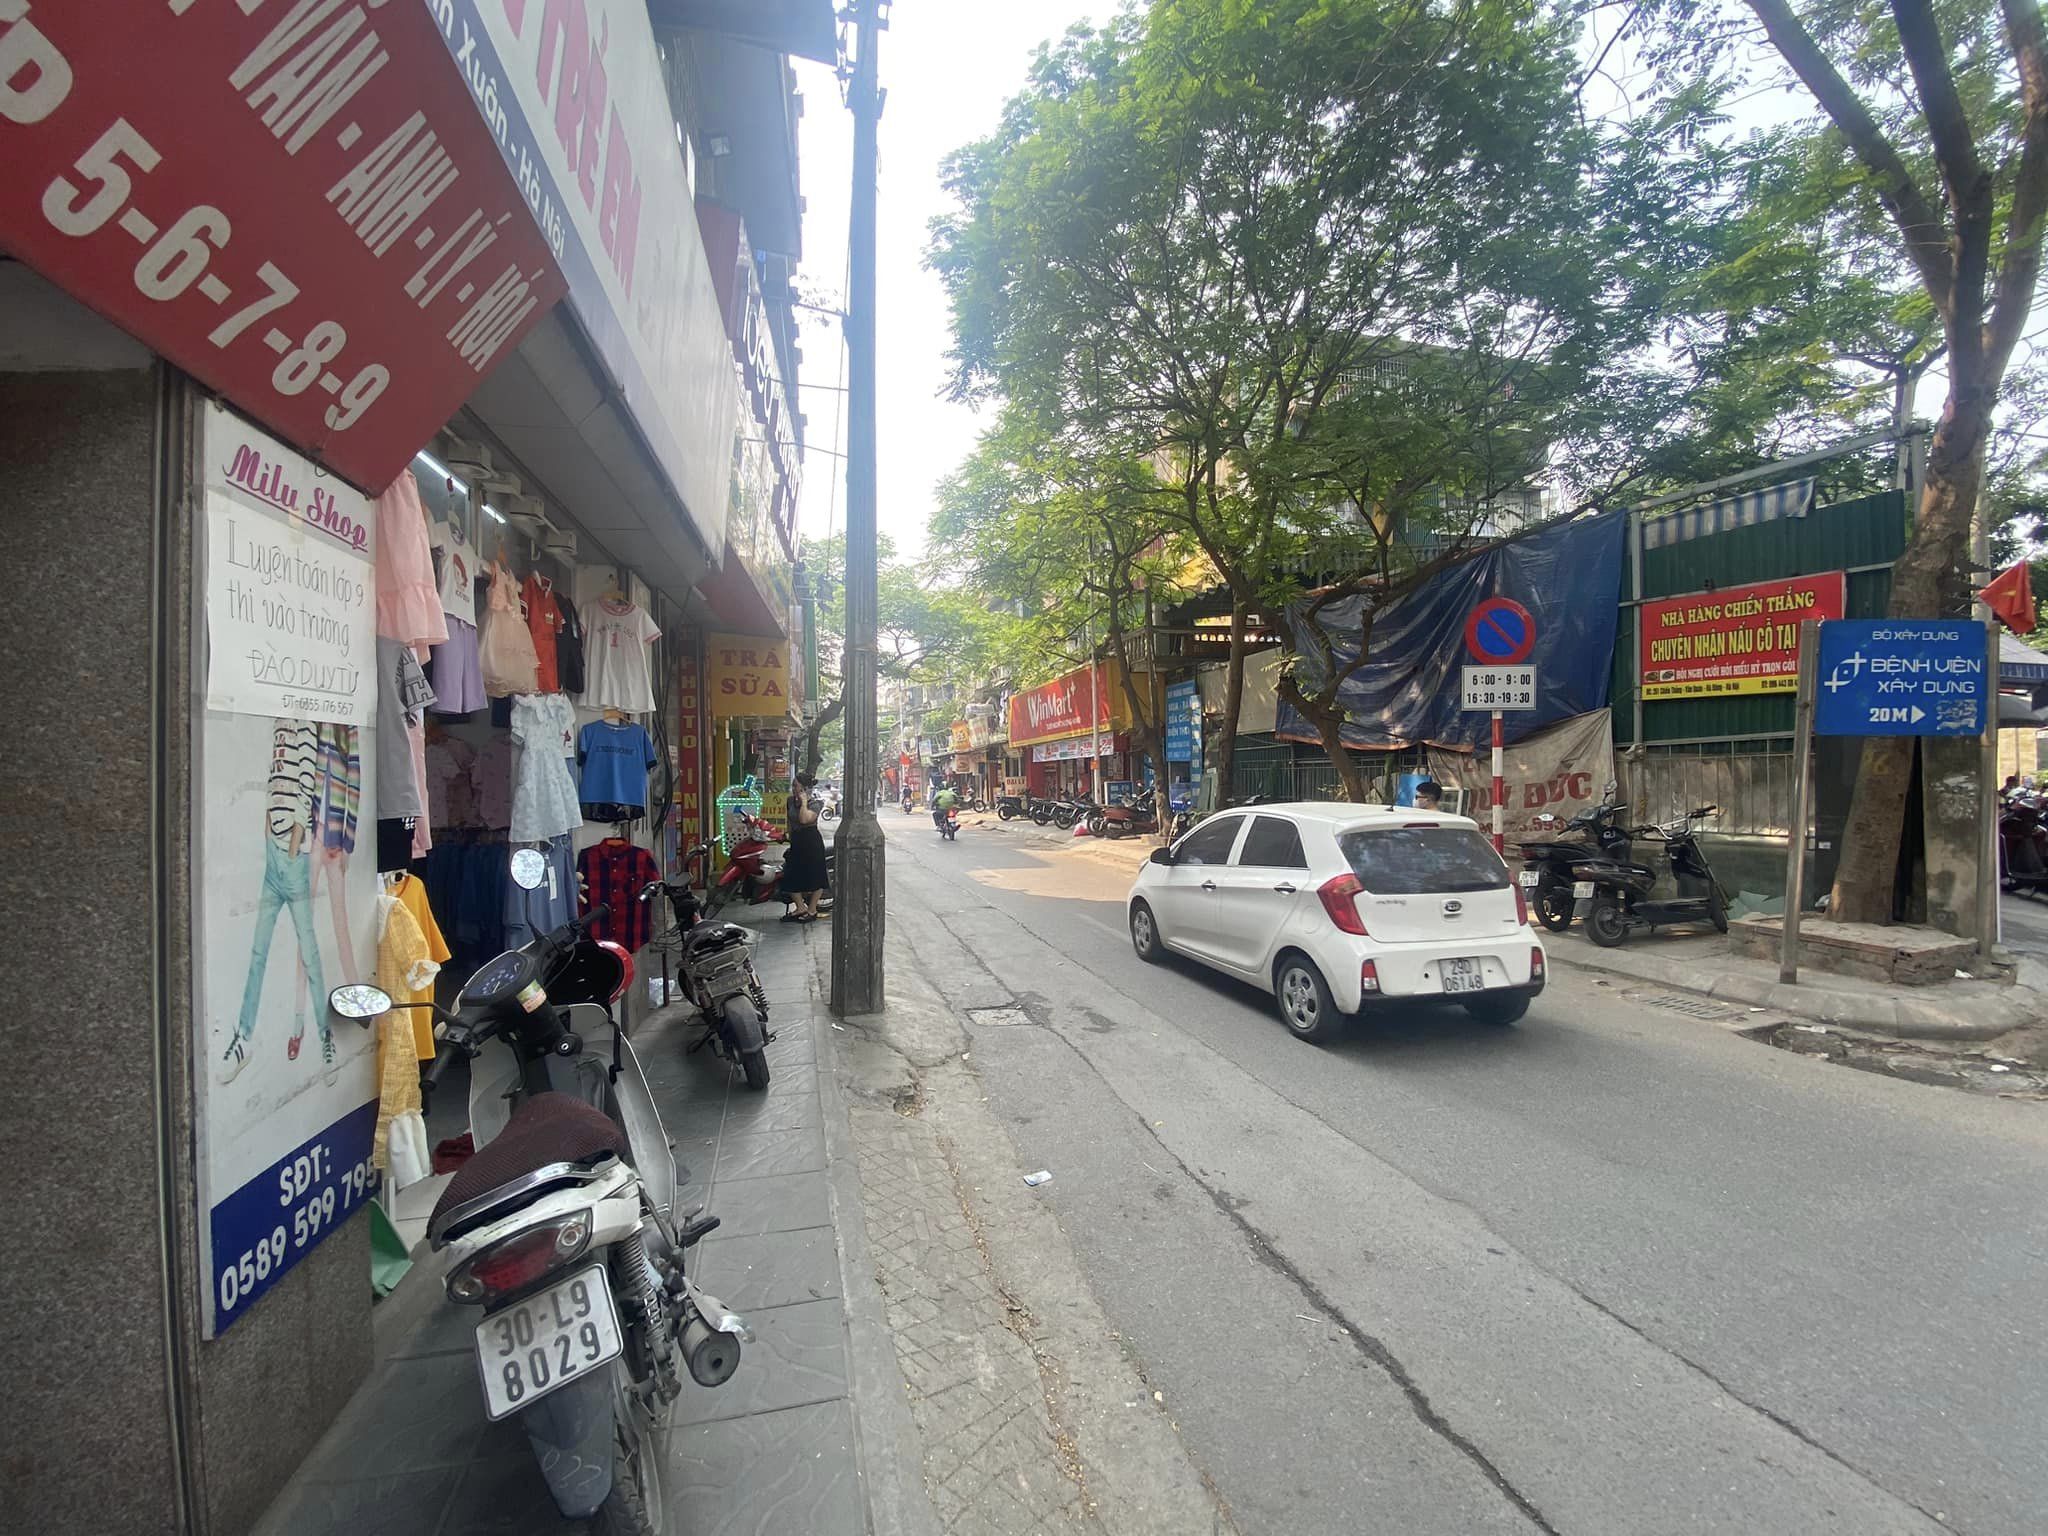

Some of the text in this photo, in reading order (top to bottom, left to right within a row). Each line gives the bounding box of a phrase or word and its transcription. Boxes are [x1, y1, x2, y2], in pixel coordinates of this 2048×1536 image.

[456, 18, 508, 147] Xuân
[519, 146, 541, 213] Hà
[325, 110, 460, 259] ANH
[403, 207, 512, 309] LÝ
[222, 443, 369, 550] Milu Shop
[225, 578, 255, 624] thi
[354, 583, 364, 608] 9
[1661, 586, 1816, 627] NHÀ HÀNG CHIẾN THẮNG
[719, 648, 782, 669] TRÀ
[1651, 632, 1692, 663] CHUYÊN
[1694, 628, 1726, 662] NHẬN
[1728, 620, 1753, 655] NẤU
[720, 673, 783, 697] SỮA
[1871, 654, 1981, 676] BỆNH VIỆN
[1877, 678, 1976, 696] XÂY DỰNG
[220, 1225, 287, 1312] 0589
[294, 1186, 335, 1249] 599
[493, 1279, 592, 1357] 30-L9
[503, 1321, 601, 1402] 8029
